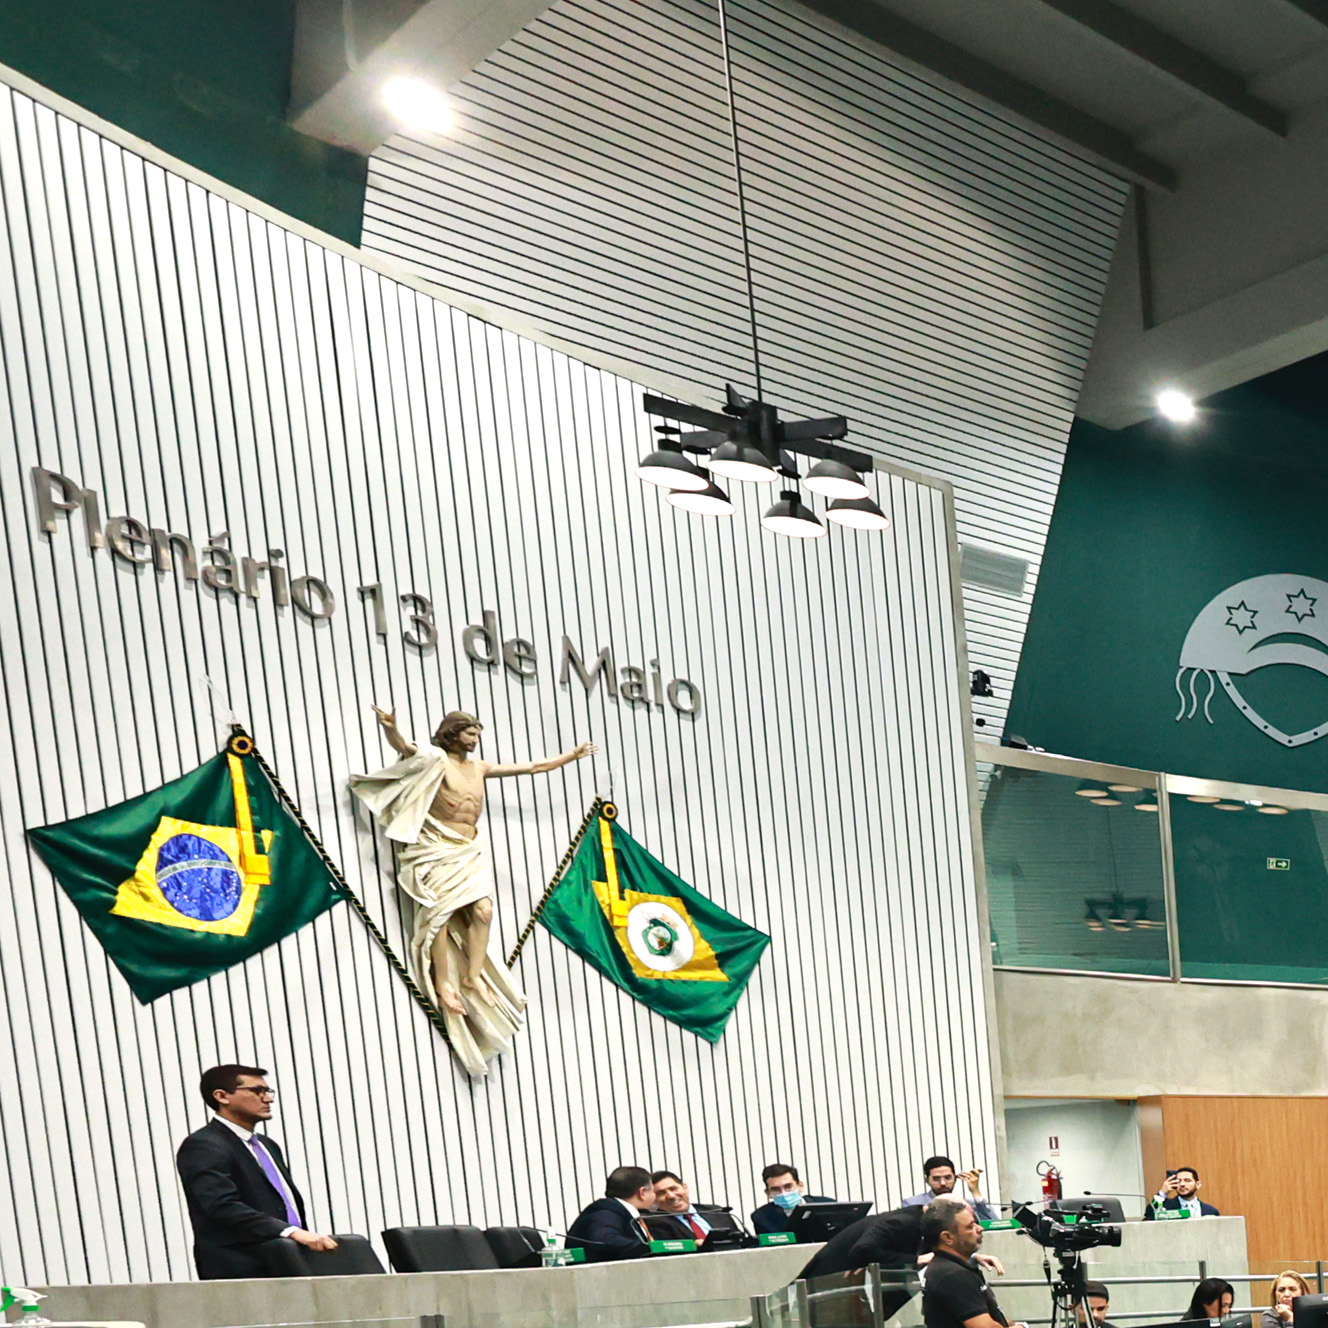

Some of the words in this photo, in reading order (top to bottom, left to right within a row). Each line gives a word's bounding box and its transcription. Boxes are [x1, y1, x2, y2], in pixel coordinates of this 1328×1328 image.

[31, 466, 335, 620] Plenário
[358, 581, 439, 653] 13
[463, 610, 538, 679] de
[559, 634, 703, 720] Maio
